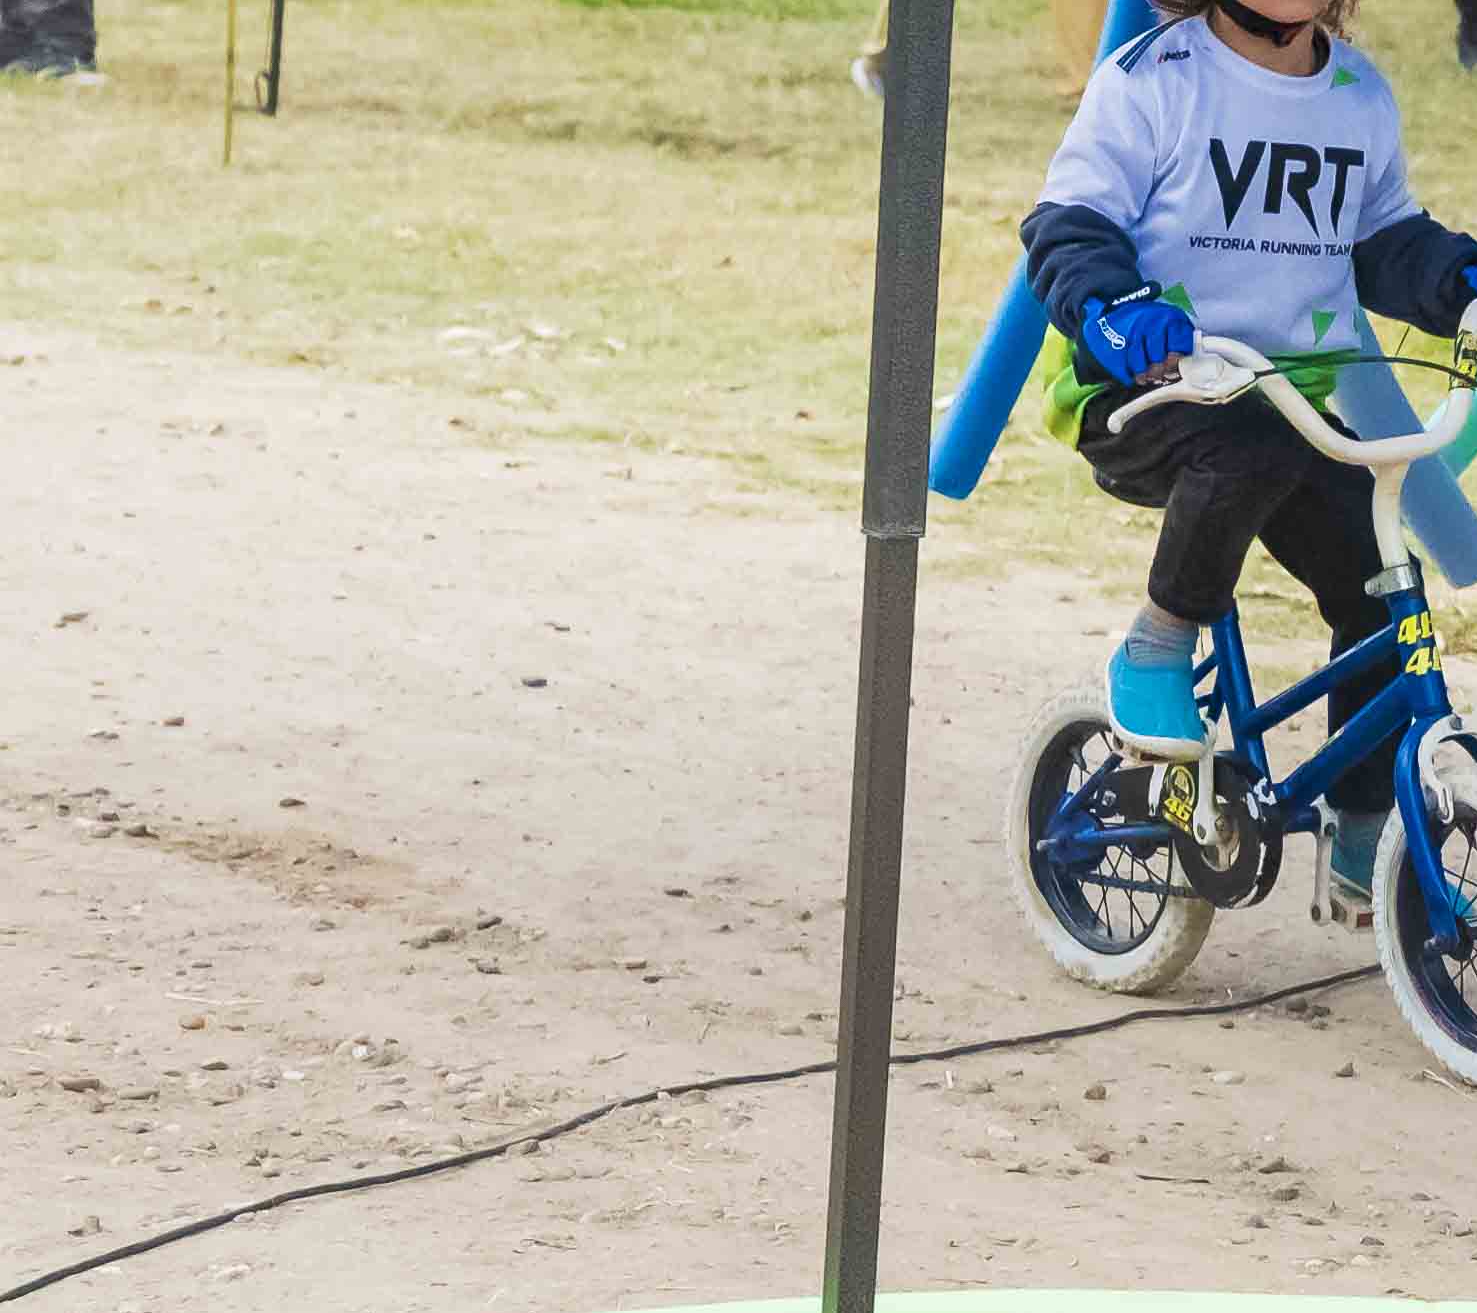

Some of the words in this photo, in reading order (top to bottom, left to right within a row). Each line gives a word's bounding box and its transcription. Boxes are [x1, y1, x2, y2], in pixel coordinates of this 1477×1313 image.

[1209, 137, 1364, 238] VRT
[1189, 236, 1256, 251] VICTORIA
[1260, 240, 1322, 256] RUNNING
